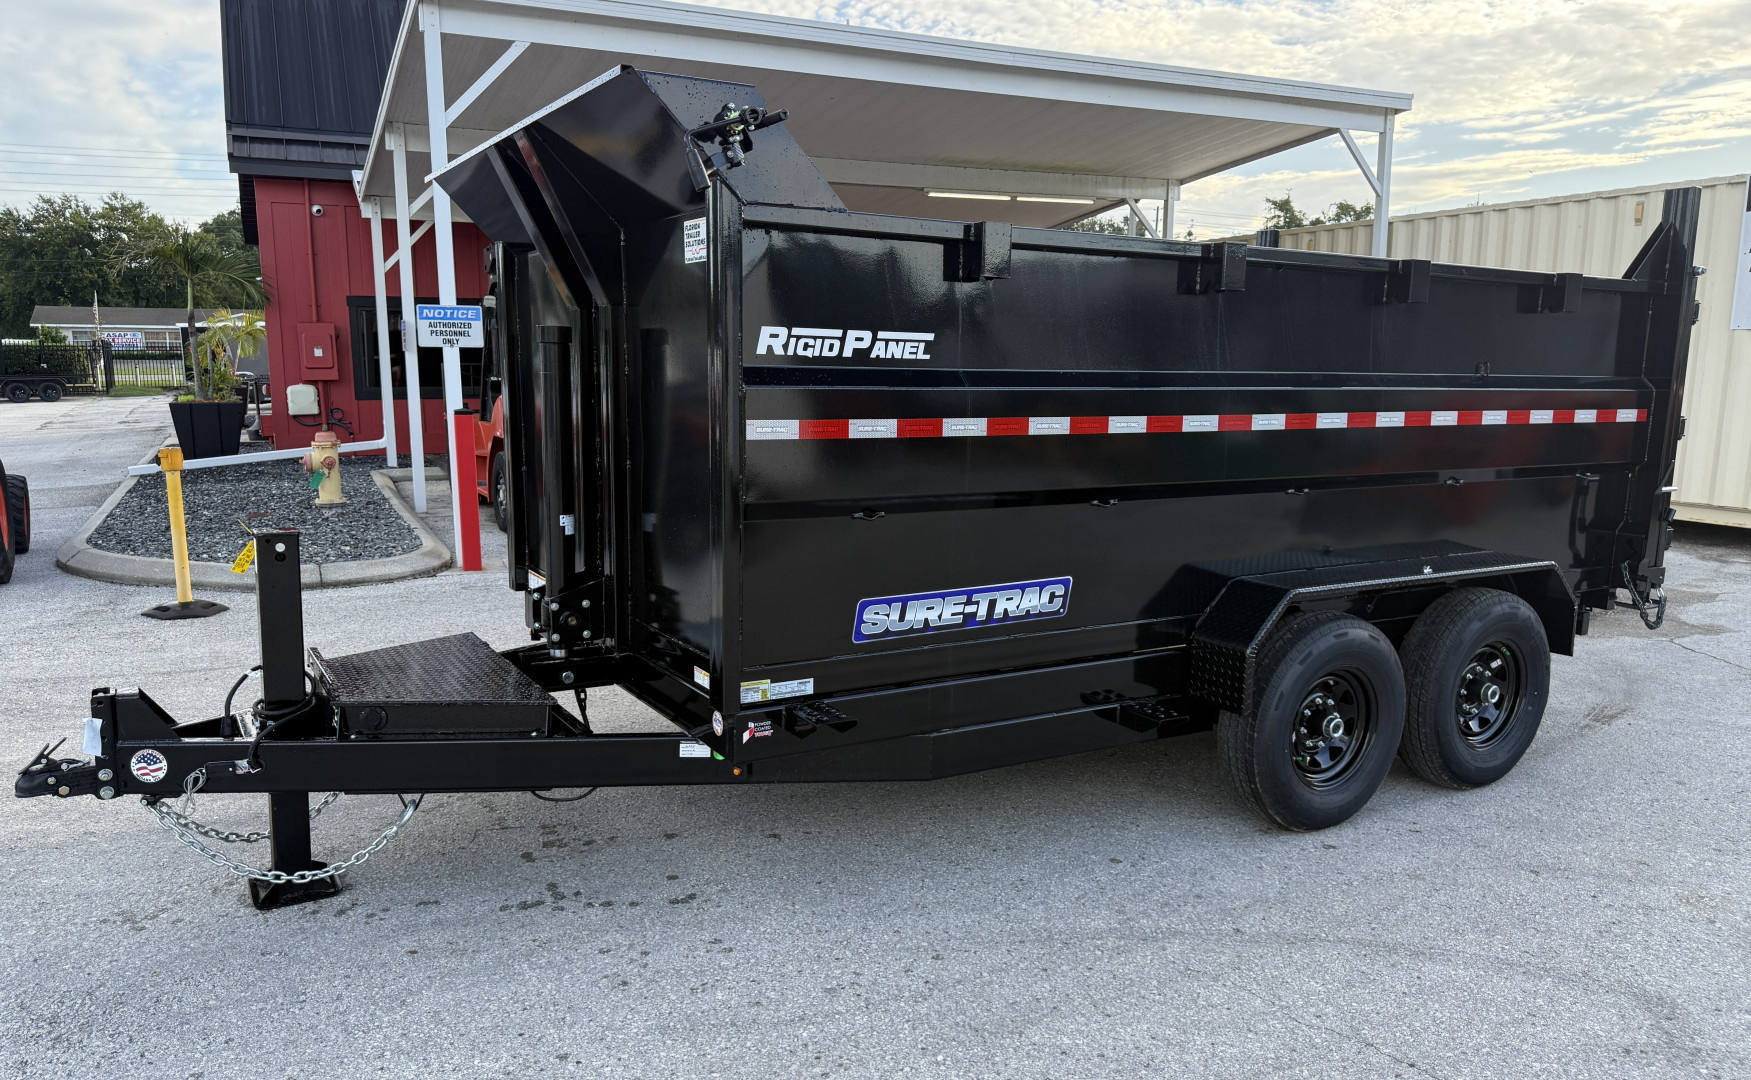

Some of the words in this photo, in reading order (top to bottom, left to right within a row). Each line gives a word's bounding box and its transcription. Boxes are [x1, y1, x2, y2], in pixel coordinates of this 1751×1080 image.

[685, 230, 701, 240] TRAILER
[685, 238, 706, 248] SOLUTIONS
[422, 309, 477, 319] NOTICE
[428, 322, 472, 330] AUTHORIZED
[860, 583, 1065, 635] SURE-TRAC
